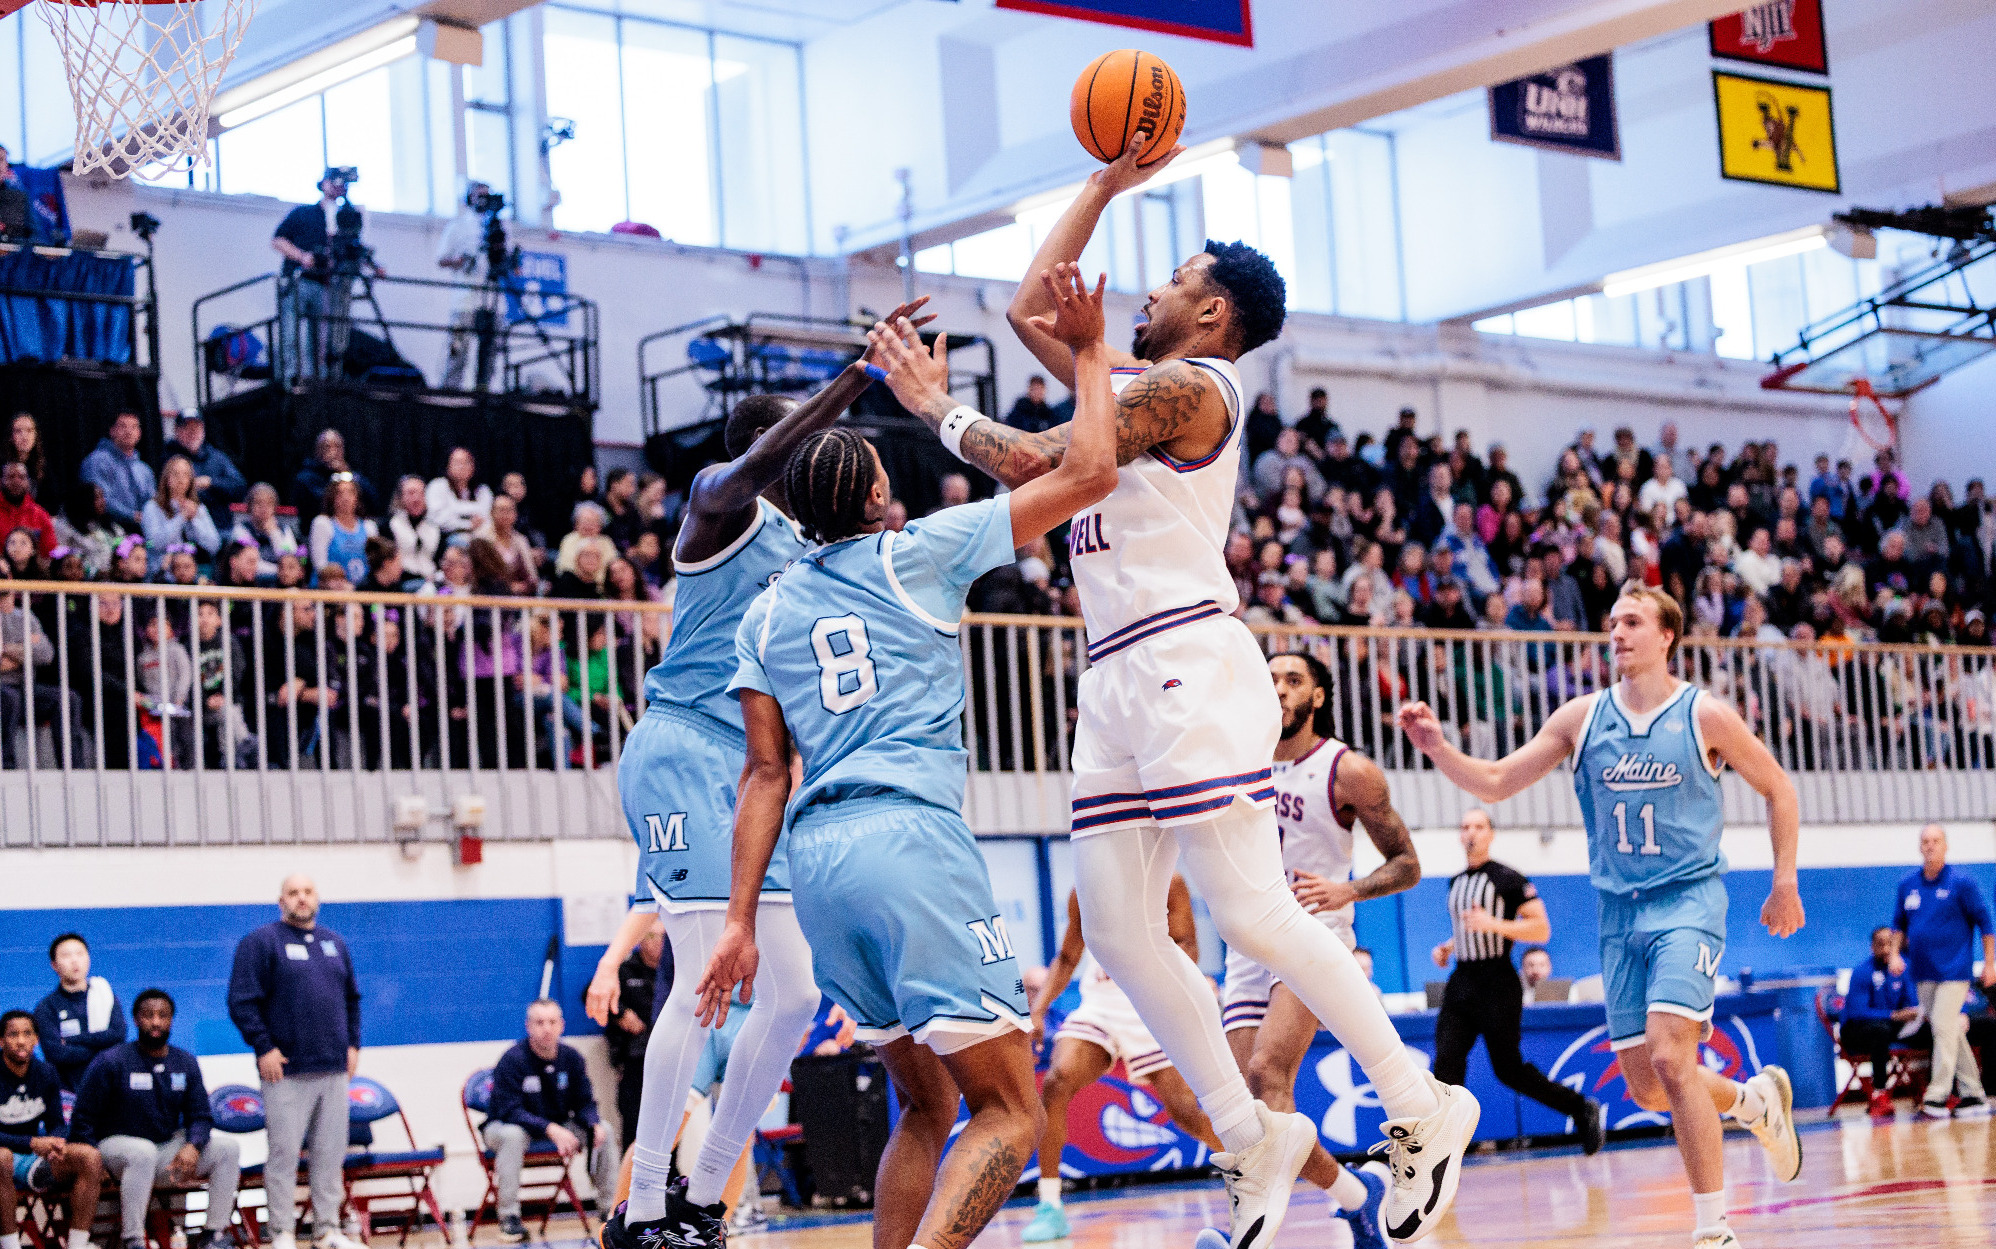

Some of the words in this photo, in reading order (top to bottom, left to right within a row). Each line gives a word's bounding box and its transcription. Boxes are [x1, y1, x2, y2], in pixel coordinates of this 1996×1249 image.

[1136, 66, 1165, 141] Wilson
[809, 611, 879, 717] 8
[1602, 753, 1683, 791] Maine
[644, 811, 690, 854] M
[1612, 801, 1663, 856] 11
[966, 914, 1015, 966] M
